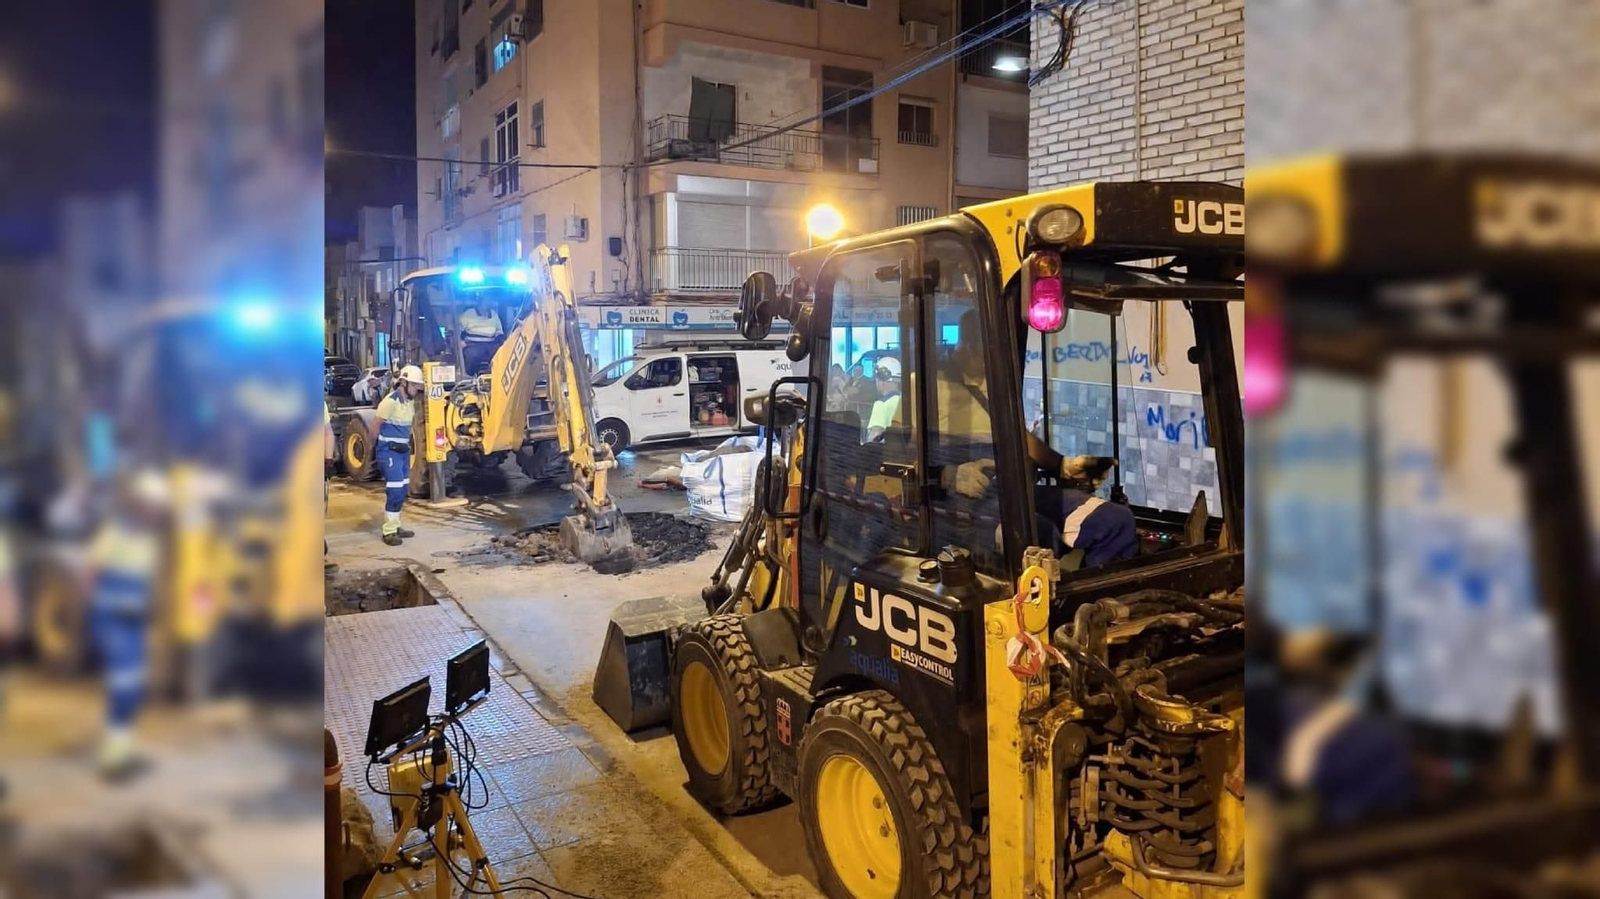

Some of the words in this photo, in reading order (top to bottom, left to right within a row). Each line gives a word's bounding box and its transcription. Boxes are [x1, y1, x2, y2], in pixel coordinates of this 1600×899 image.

[1174, 199, 1245, 235] JCB
[501, 334, 526, 393] JCB
[430, 386, 442, 398] 40
[853, 582, 958, 664] JCB
